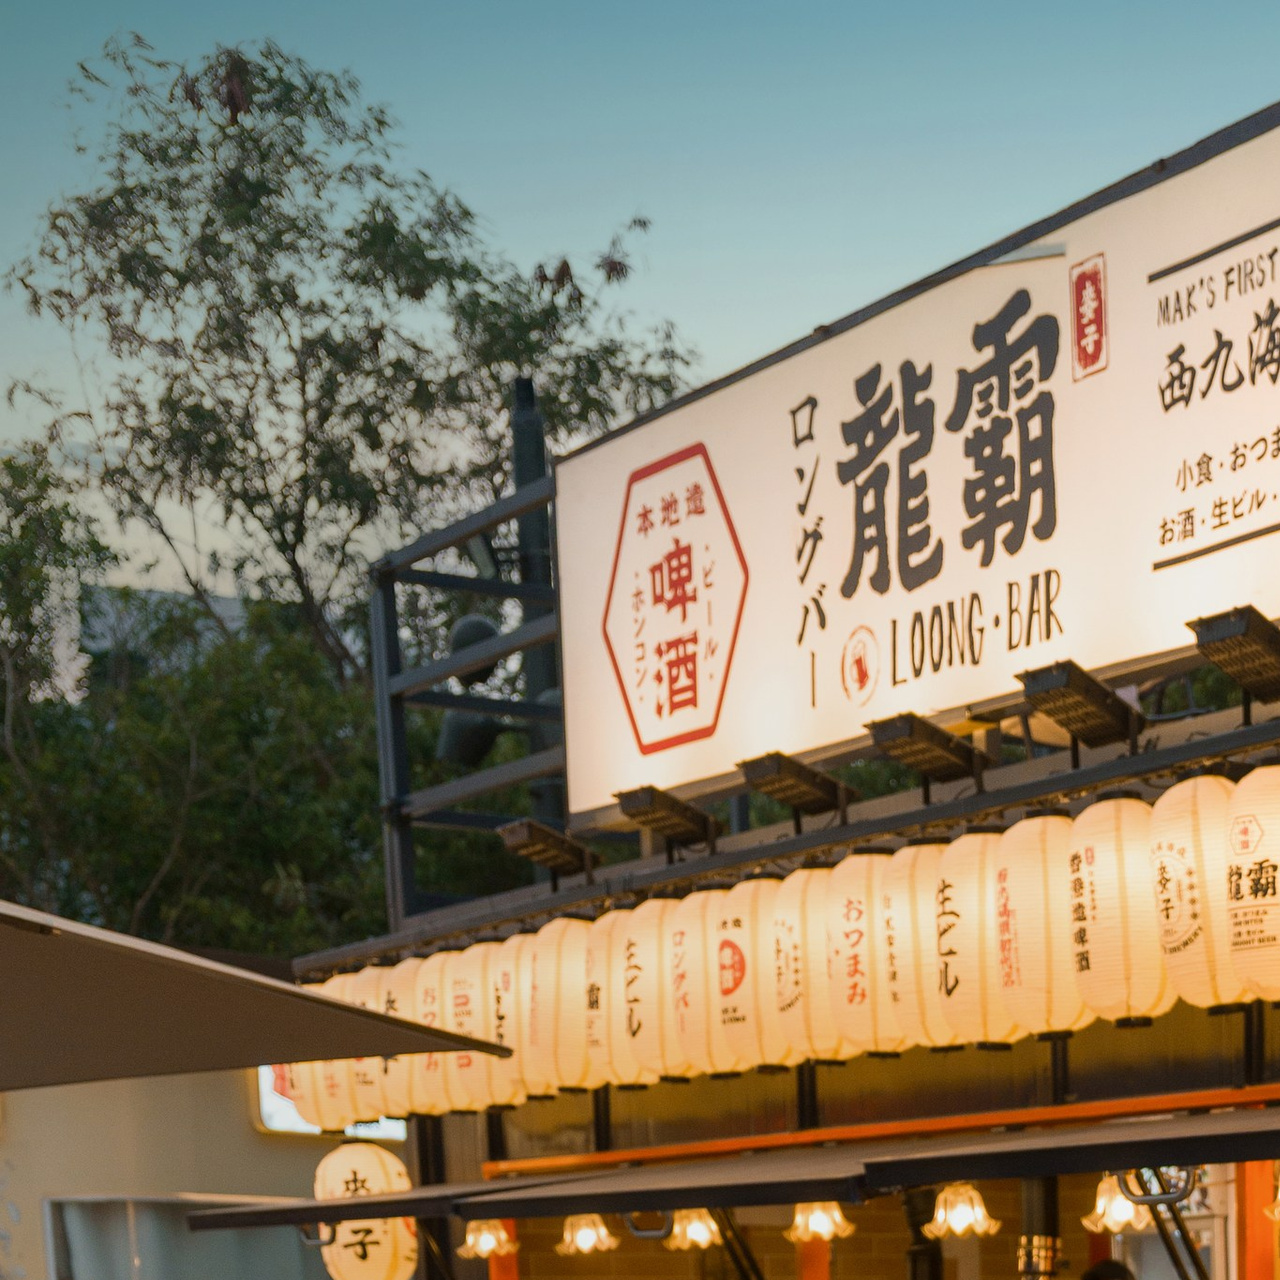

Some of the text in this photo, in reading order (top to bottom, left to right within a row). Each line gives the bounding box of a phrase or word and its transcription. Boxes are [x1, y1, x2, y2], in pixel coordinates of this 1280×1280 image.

[1157, 275, 1216, 327] MAK'S
[1223, 248, 1279, 301] FIRST
[836, 289, 1061, 600] 龍霸
[649, 538, 698, 720] 啤酒
